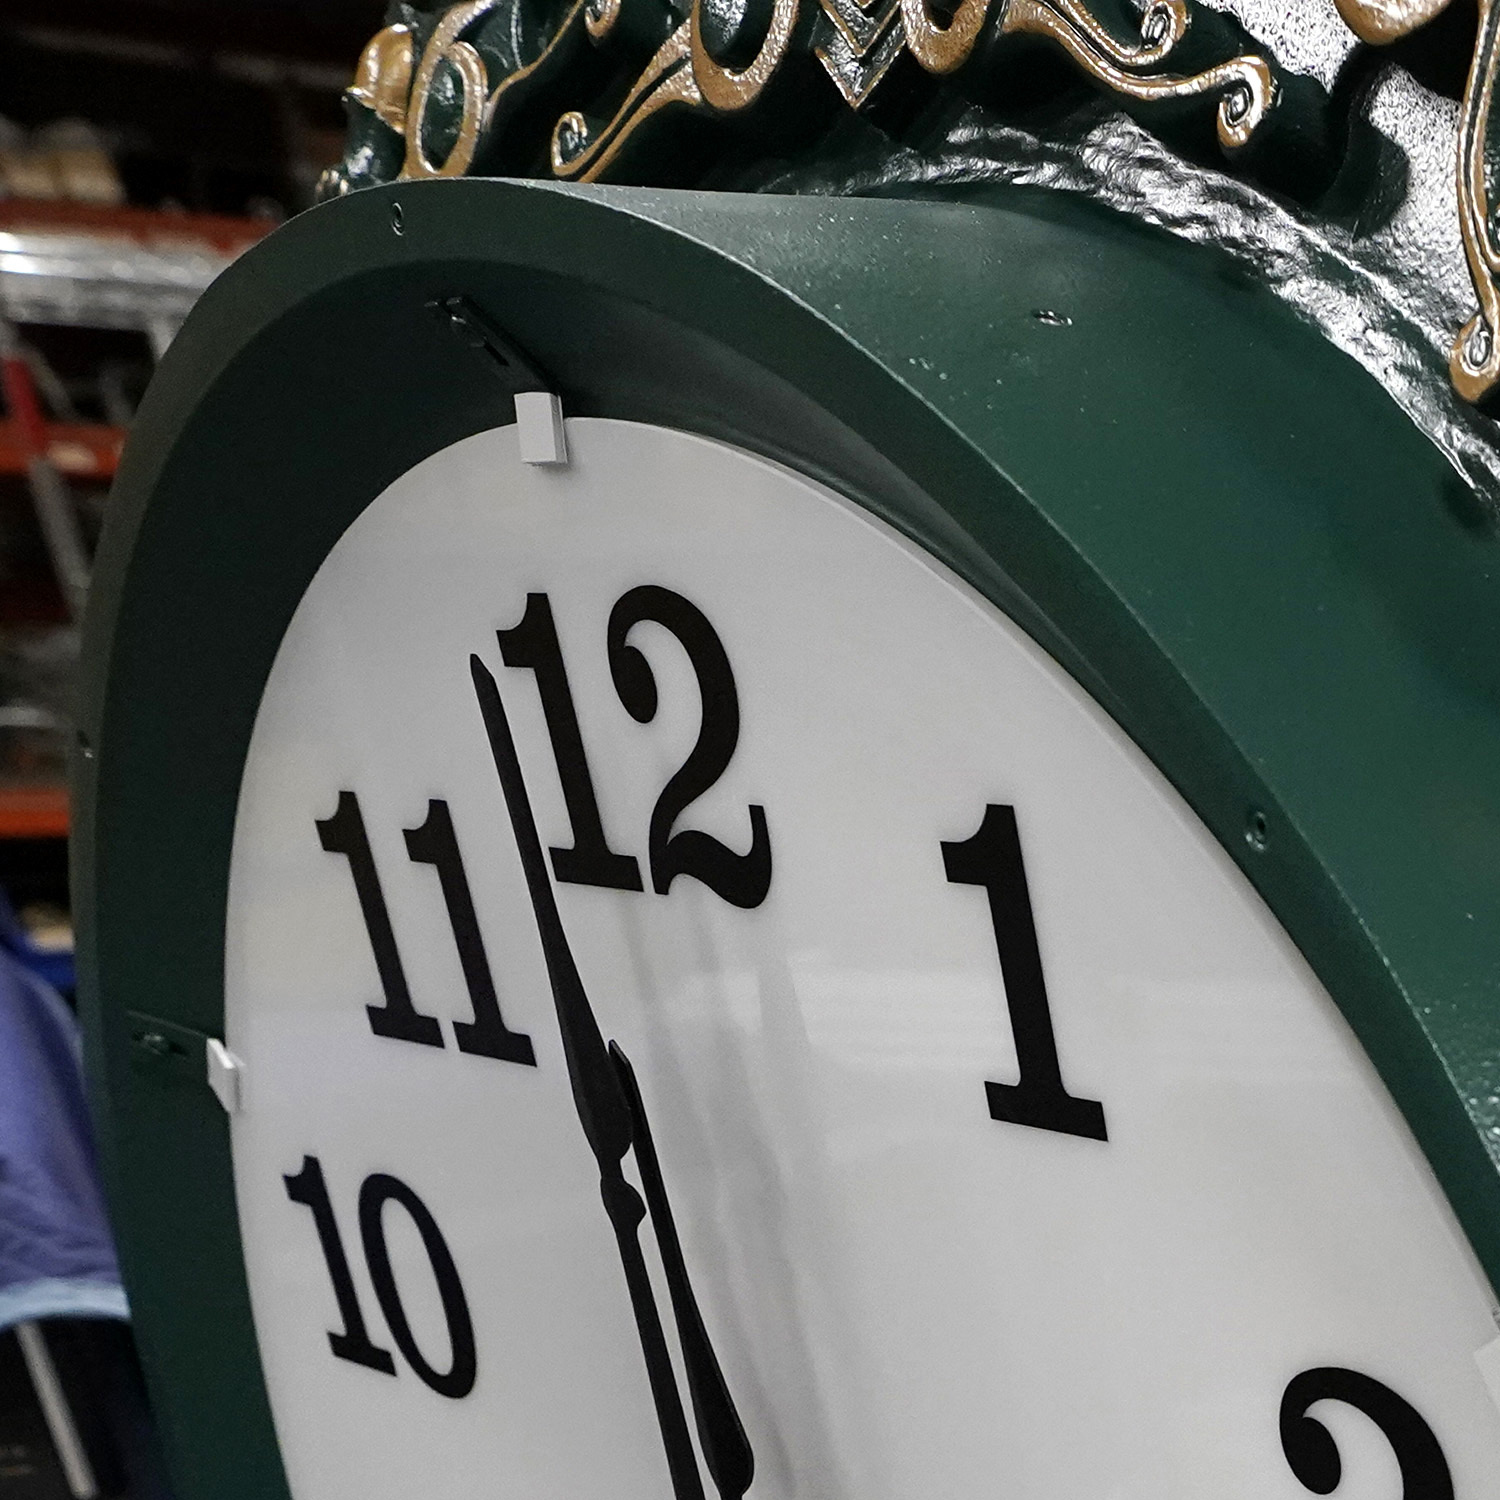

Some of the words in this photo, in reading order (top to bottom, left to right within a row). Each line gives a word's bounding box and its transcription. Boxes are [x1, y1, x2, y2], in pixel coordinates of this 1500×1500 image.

[498, 585, 772, 909] 12
[315, 791, 537, 1067] 11
[940, 804, 1108, 1142] 1
[283, 1155, 477, 1399] 10
